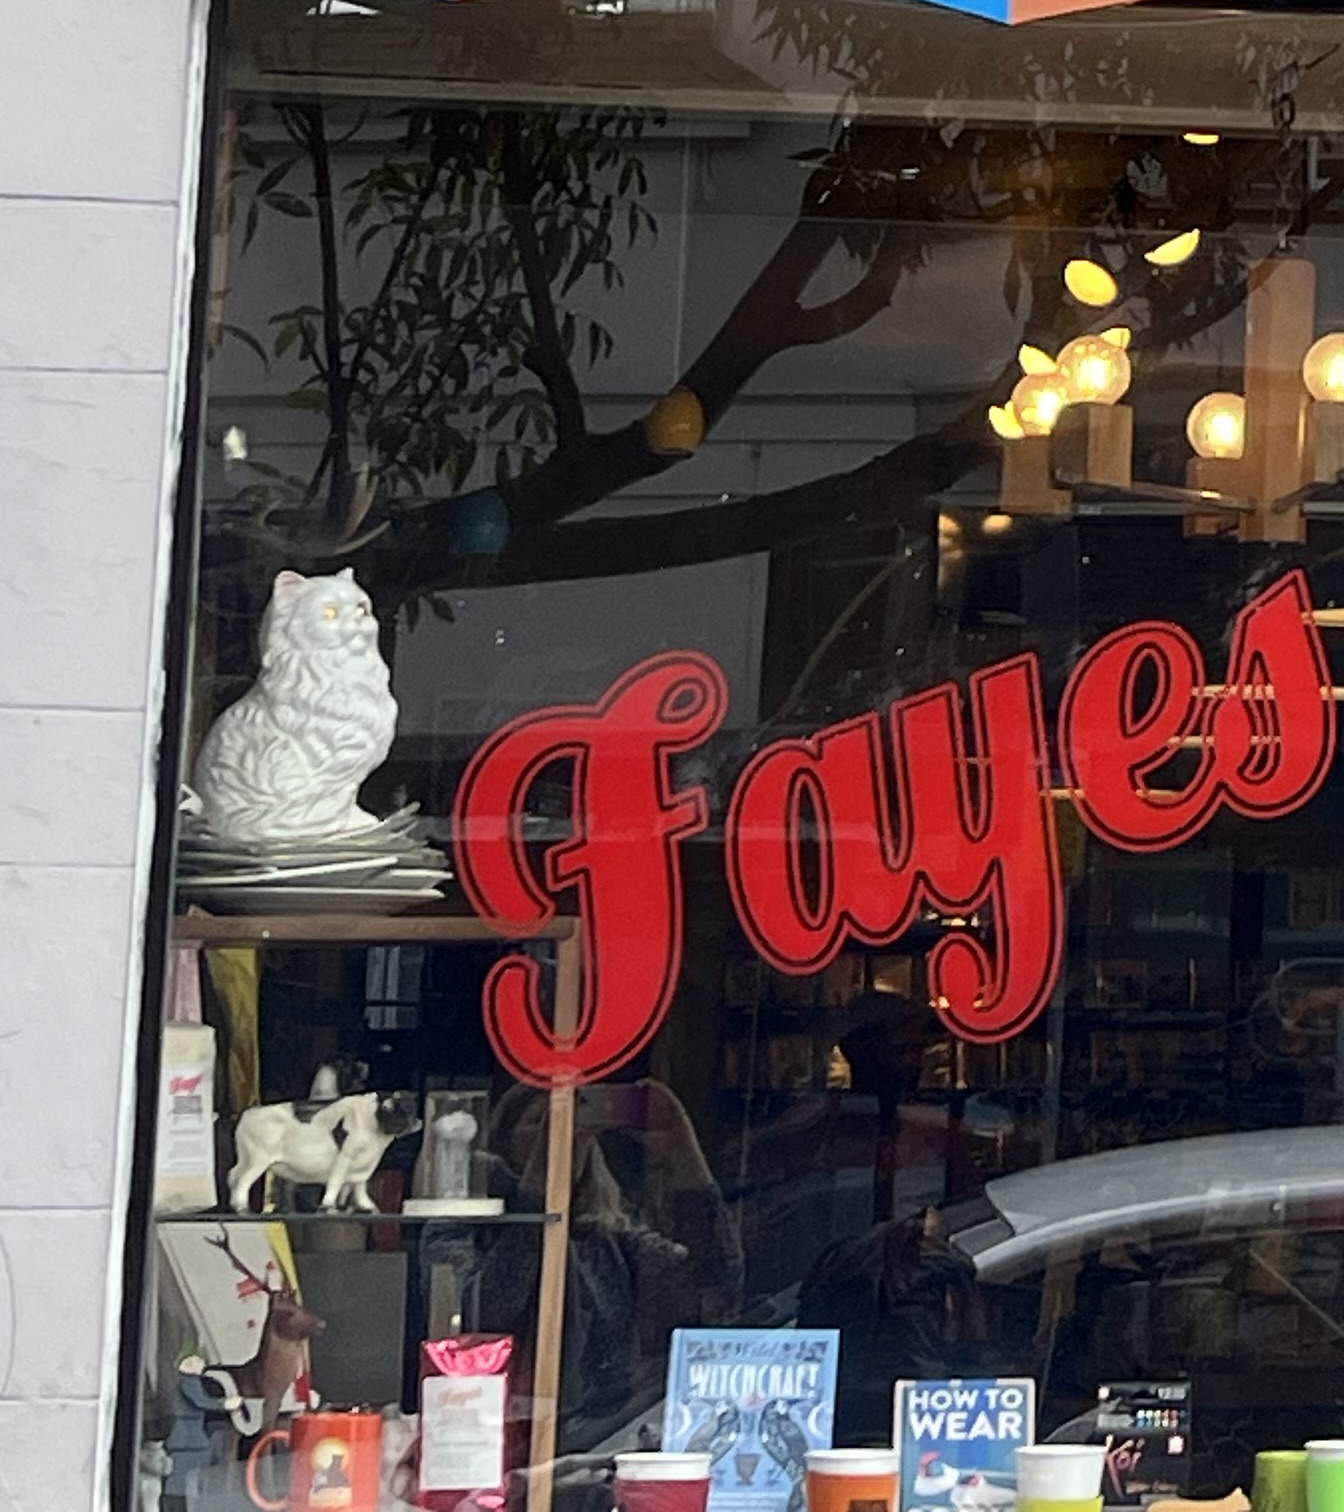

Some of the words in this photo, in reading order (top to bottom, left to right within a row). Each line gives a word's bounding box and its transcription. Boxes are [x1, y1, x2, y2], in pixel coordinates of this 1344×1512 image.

[453, 568, 1336, 1086] Fayes
[688, 1363, 821, 1399] WITCHCRAFT
[909, 1389, 980, 1411] HOW
[983, 1389, 1023, 1410] TO
[908, 1411, 1023, 1441] WEAR
